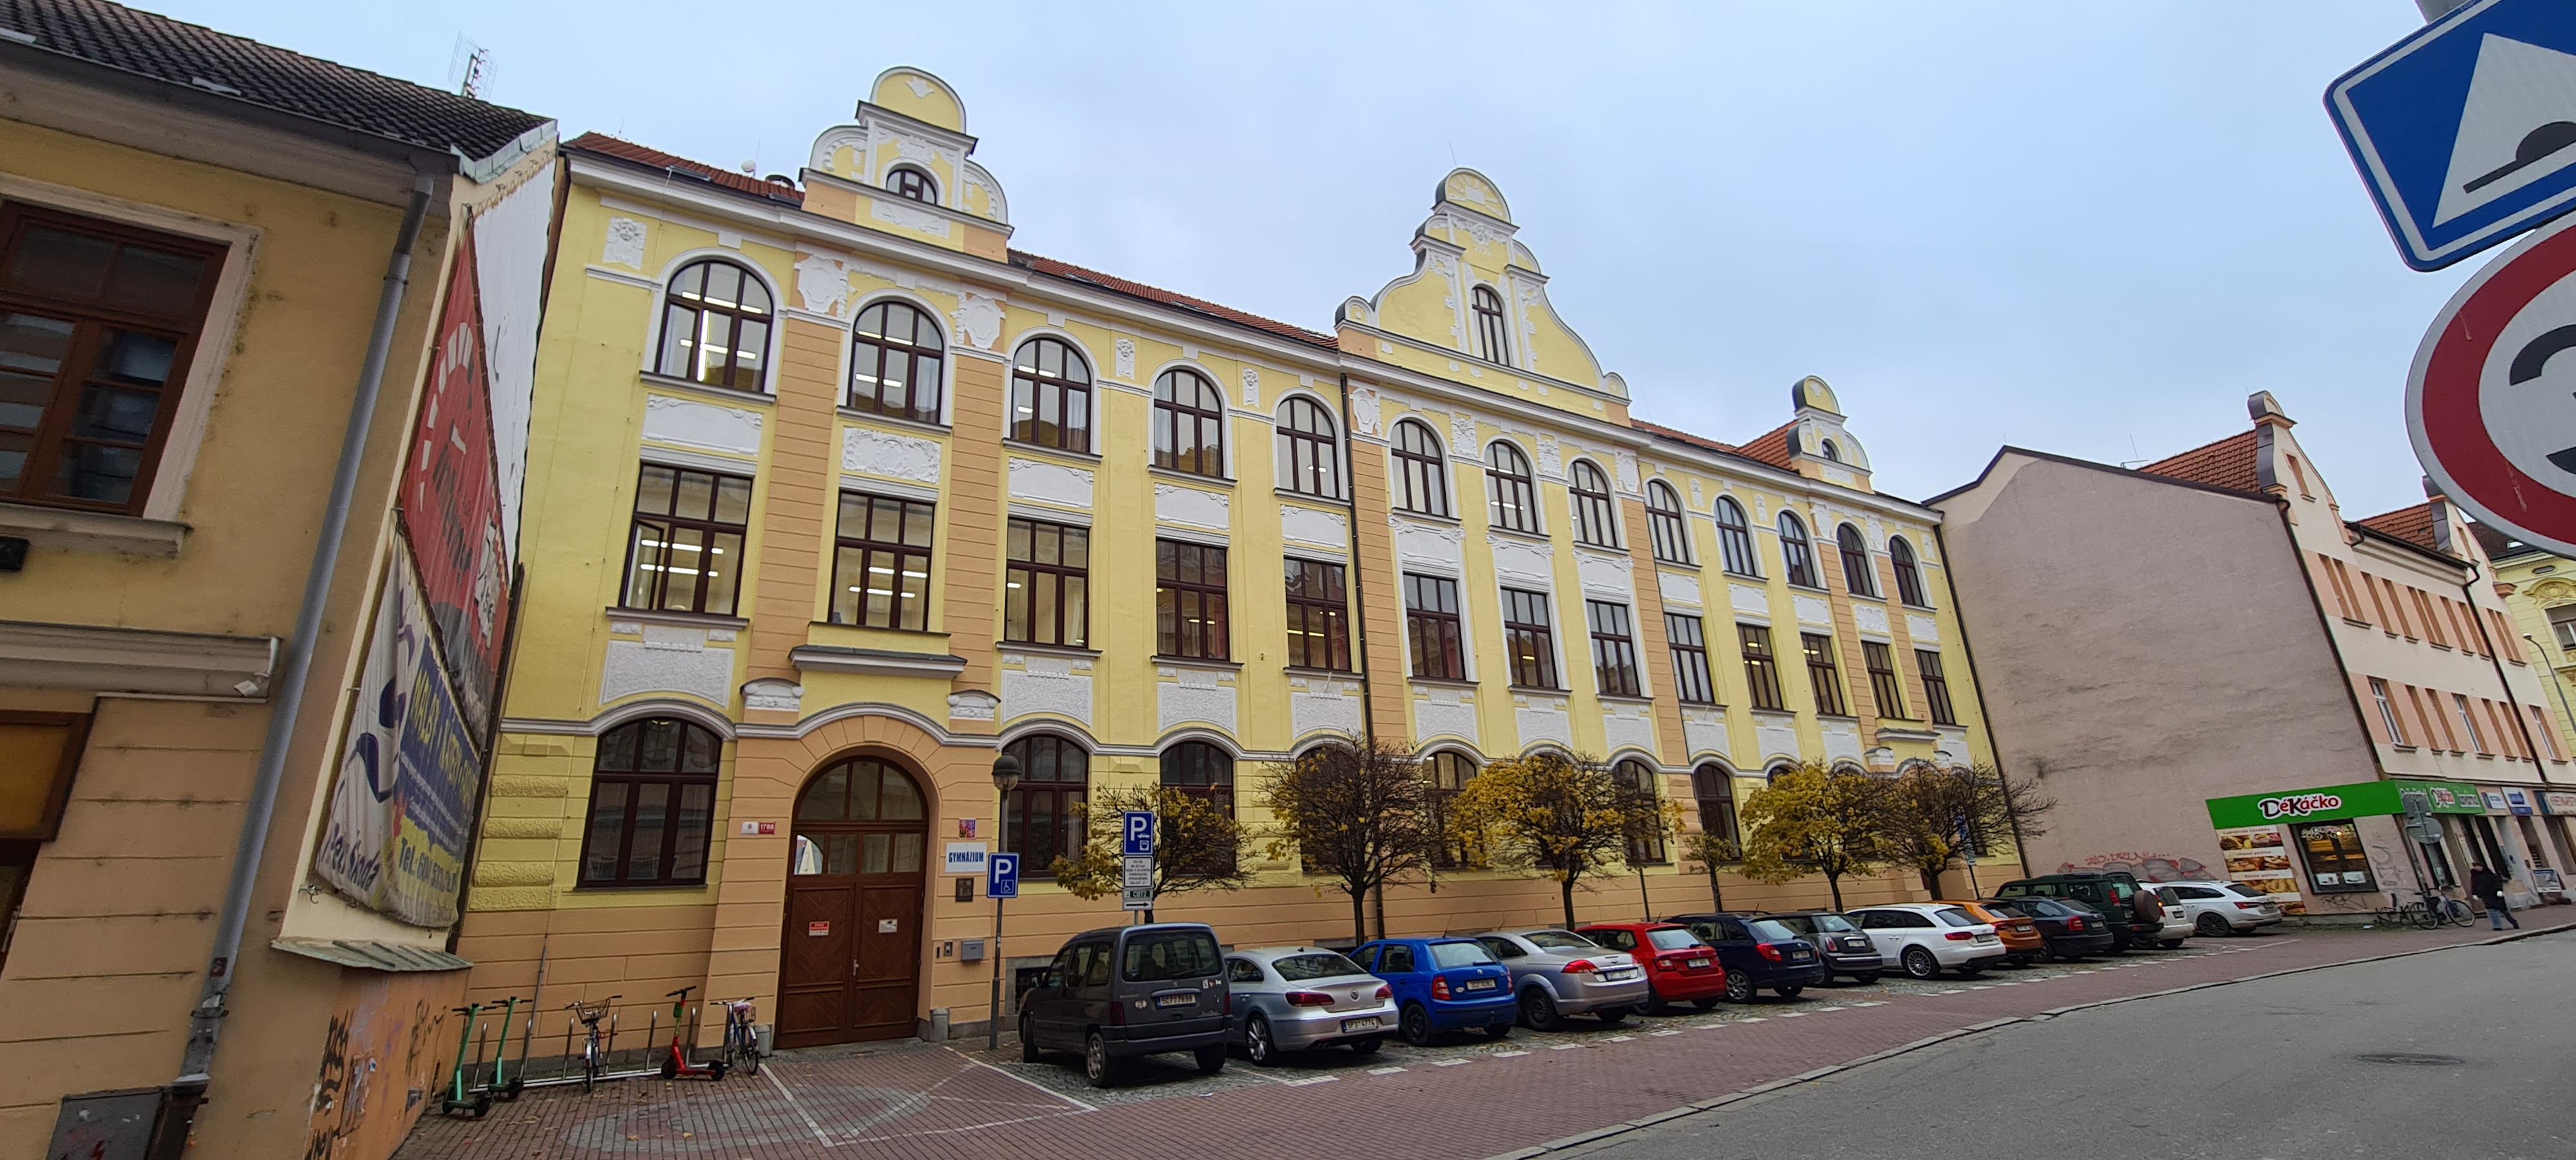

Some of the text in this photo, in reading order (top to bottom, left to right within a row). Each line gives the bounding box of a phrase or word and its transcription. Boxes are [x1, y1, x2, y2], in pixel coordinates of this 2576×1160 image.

[2259, 795, 2339, 817] DéKáčko
[1130, 817, 1147, 841] P
[949, 850, 984, 862] GYMNÁZIUM
[994, 859, 1012, 884] P
